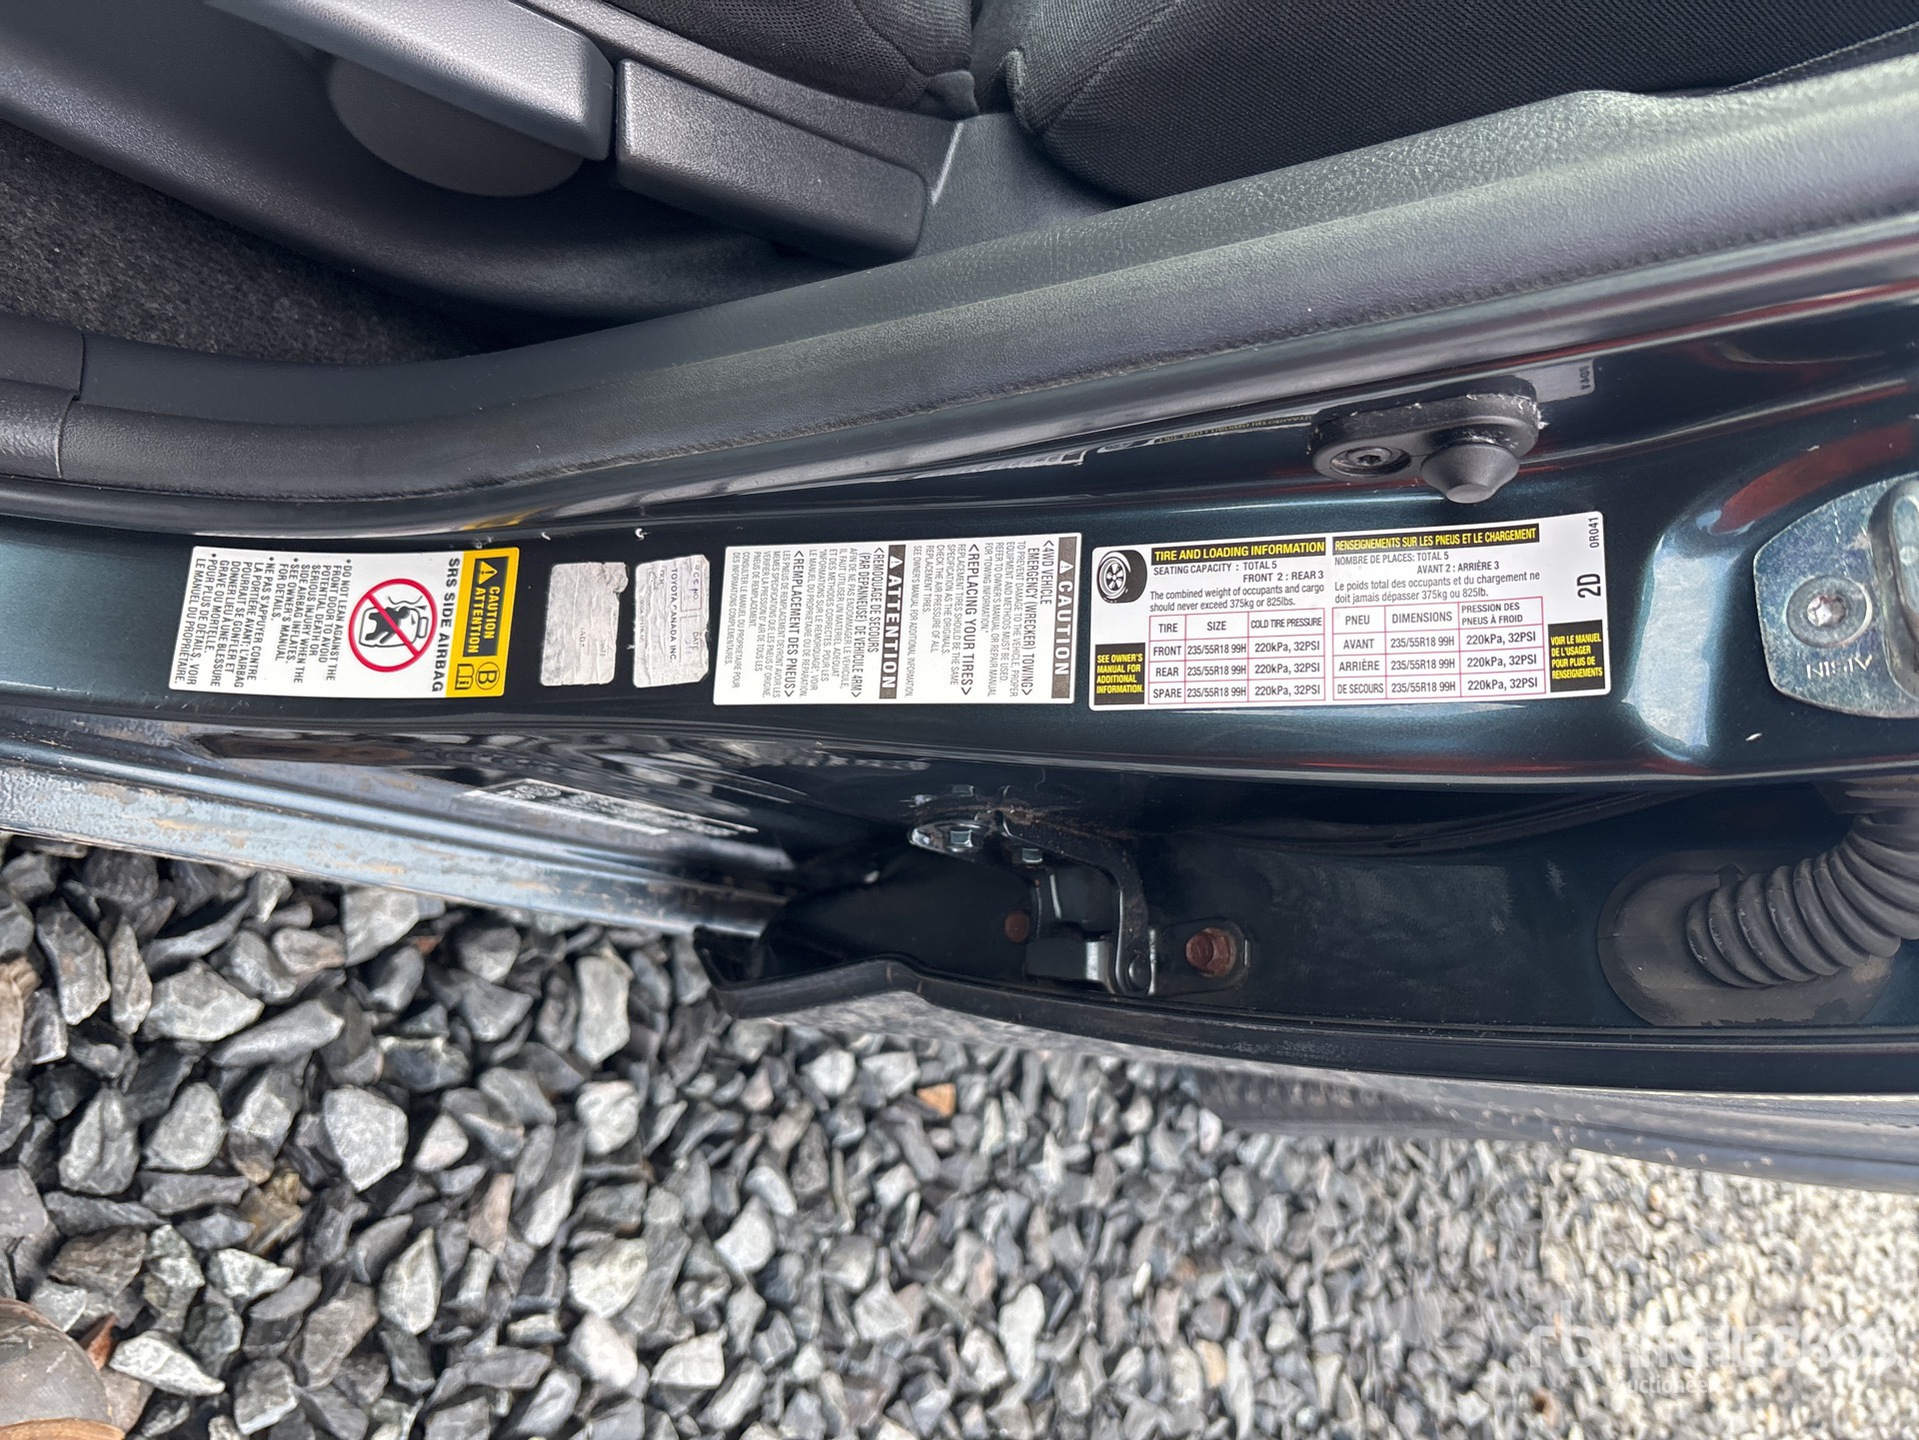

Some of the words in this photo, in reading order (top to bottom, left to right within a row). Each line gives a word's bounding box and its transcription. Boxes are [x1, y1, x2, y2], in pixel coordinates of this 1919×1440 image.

[1017, 541, 1025, 550] TO
[1335, 537, 1400, 552] RENSEIGNEMENTS
[1402, 536, 1418, 547] SUR
[1419, 535, 1433, 546] LES
[1435, 533, 1460, 546] PNEUS
[1462, 532, 1472, 544] ET
[1474, 531, 1483, 543] LE
[1485, 528, 1536, 543] CHARGEMENT
[783, 550, 791, 561] LES
[858, 552, 872, 569] (PAR
[1042, 540, 1054, 567] <4WD
[1155, 550, 1176, 561] TIRE
[1179, 549, 1198, 560] AND
[1200, 546, 1248, 559] LOADING
[1251, 541, 1324, 557] INFORMATION
[1335, 555, 1368, 566] NOMBRE
[1369, 555, 1380, 564] DE
[1382, 553, 1415, 564] PLACES:
[1417, 552, 1442, 562] TOTAL
[1444, 552, 1449, 560] 5
[195, 558, 206, 568] LE
[253, 562, 264, 573] LA
[265, 563, 276, 574] NE
[277, 564, 289, 581] FOR
[289, 564, 300, 579] SEE
[342, 565, 353, 577] DO
[445, 558, 460, 587] SRS
[781, 562, 790, 581] PNEUS
[1015, 551, 1025, 582] PREVENT
[1154, 566, 1188, 576] SEATING
[1191, 563, 1232, 574] CAPACITY
[1243, 561, 1270, 570] TOTAL
[1271, 561, 1277, 569] 5
[299, 564, 311, 584] SIDE
[307, 565, 321, 602] SERIOUS
[329, 565, 342, 594] FRONT
[871, 547, 885, 602] <REMOQUAGE
[965, 544, 980, 615] <REPLACING
[1025, 548, 1039, 599] EMERGENCY
[189, 570, 204, 604] MANUEL
[262, 576, 273, 592] PAS
[316, 565, 332, 611] POTENTIAL
[339, 580, 350, 598] NOT
[788, 550, 805, 634] <REMPLACEMENT
[1040, 569, 1053, 605] VEHICLE
[1150, 591, 1163, 601] The
[1166, 588, 1202, 600] combined
[1205, 587, 1231, 600] weight
[1233, 586, 1241, 596] of
[1242, 585, 1282, 598] occupants
[1285, 584, 1299, 594] and
[1301, 583, 1324, 595] cargo
[1577, 573, 1602, 598] 2D
[246, 575, 264, 616] PORTIÈRE
[270, 583, 286, 621] DETAILS.
[282, 582, 297, 622] OWNER'S
[293, 586, 307, 618] AIRBAG
[854, 571, 870, 622] DEPANNEUSE)
[1014, 583, 1023, 611] DAMAGE
[1150, 602, 1174, 612] should
[1177, 602, 1198, 611] never
[1200, 600, 1227, 610] exceed
[1230, 598, 1254, 610] 375kg
[1256, 599, 1264, 607] or
[1267, 596, 1295, 607] 825lbs.
[186, 607, 198, 619] DU
[325, 596, 337, 620] DOOR
[335, 600, 347, 621] LEAN
[440, 593, 455, 628] SIDE
[484, 586, 501, 639] CAUTION
[777, 591, 788, 638] REMPLACEMENT
[870, 605, 881, 614] DE
[1013, 613, 1022, 622] TO
[1392, 611, 1453, 624] DIMENSIONS
[1462, 603, 1502, 613] PRESSION
[1503, 602, 1520, 611] DES
[253, 595, 270, 643] S'APPUYER
[301, 605, 315, 635] INJURY
[311, 614, 324, 641] DEATH
[323, 623, 333, 634] TO
[468, 587, 486, 653] ATTENTION
[1022, 602, 1038, 650] (WRECKER)
[1055, 581, 1072, 675] CAUTION
[1158, 623, 1178, 633] TIRE
[1207, 621, 1227, 631] SIZE
[1251, 620, 1269, 629] COLD
[1271, 619, 1285, 628] TIRE
[1287, 617, 1322, 628] PRESSURE
[1345, 615, 1370, 626] PNEU
[1462, 616, 1489, 626] PNEUS
[1499, 614, 1523, 624] FROID
[240, 618, 255, 647] AVANT;
[855, 626, 866, 634] DE
[867, 616, 881, 653] SECOURS
[882, 576, 901, 688] ATTENTION
[963, 618, 976, 649] YOUR
[1012, 624, 1021, 636] THE
[1466, 633, 1505, 647] 220kPa,
[1508, 632, 1536, 643] 32PSI
[275, 625, 290, 661] MANUAL
[285, 621, 302, 663] INFLATES.
[296, 638, 310, 663] WHEN
[308, 644, 319, 656] OR
[318, 637, 331, 663] AVOID
[329, 624, 343, 661] AGAINST
[787, 637, 799, 655] DES
[1153, 646, 1181, 657] FRONT
[1188, 644, 1229, 655] 235/55R18
[1231, 644, 1246, 653] 99H
[1255, 642, 1291, 654] 220kPa,
[1294, 641, 1320, 651] 32PSI
[1343, 639, 1374, 650] AVANT
[1390, 637, 1436, 649] 235/55R18
[1438, 636, 1455, 646] 99H
[247, 646, 262, 680] CONTRE
[432, 633, 450, 692] AIRBAG
[775, 640, 784, 666] DEVRONT
[852, 637, 865, 673] VEHICULE
[1010, 638, 1020, 668] VEHICLE,
[1097, 655, 1110, 663] SEE
[1111, 653, 1143, 663] OWNER'S
[233, 649, 249, 688] L'AIRBAG
[293, 666, 305, 683] THE
[326, 664, 337, 681] THE
[477, 670, 497, 685] B
[773, 668, 782, 686] AVOIR
[784, 658, 797, 697] PNEUS>
[960, 654, 974, 695] TIRES>
[1021, 654, 1034, 695] TOWING>
[1097, 665, 1125, 674] MANUAL
[1127, 664, 1141, 672] FOR
[850, 675, 863, 698] 4RM>
[1009, 670, 1019, 697] PROPER
[1097, 675, 1137, 684] ADDITIONAL
[1097, 684, 1144, 694] INFORMATION.
[1337, 685, 1347, 694] DE
[1349, 683, 1384, 694] SECOURS
[1391, 682, 1438, 694] 235/55R18
[1439, 681, 1456, 691] 99H
[1468, 679, 1507, 693] 220kPa,
[1509, 677, 1537, 689] 32PSI
[772, 687, 781, 698] LES
[1153, 688, 1182, 698] SPARE
[1187, 687, 1229, 698] 235/55R18
[1231, 687, 1246, 696] 99H
[1255, 685, 1291, 697] 220kPa,
[1294, 685, 1320, 695] 32PSI
